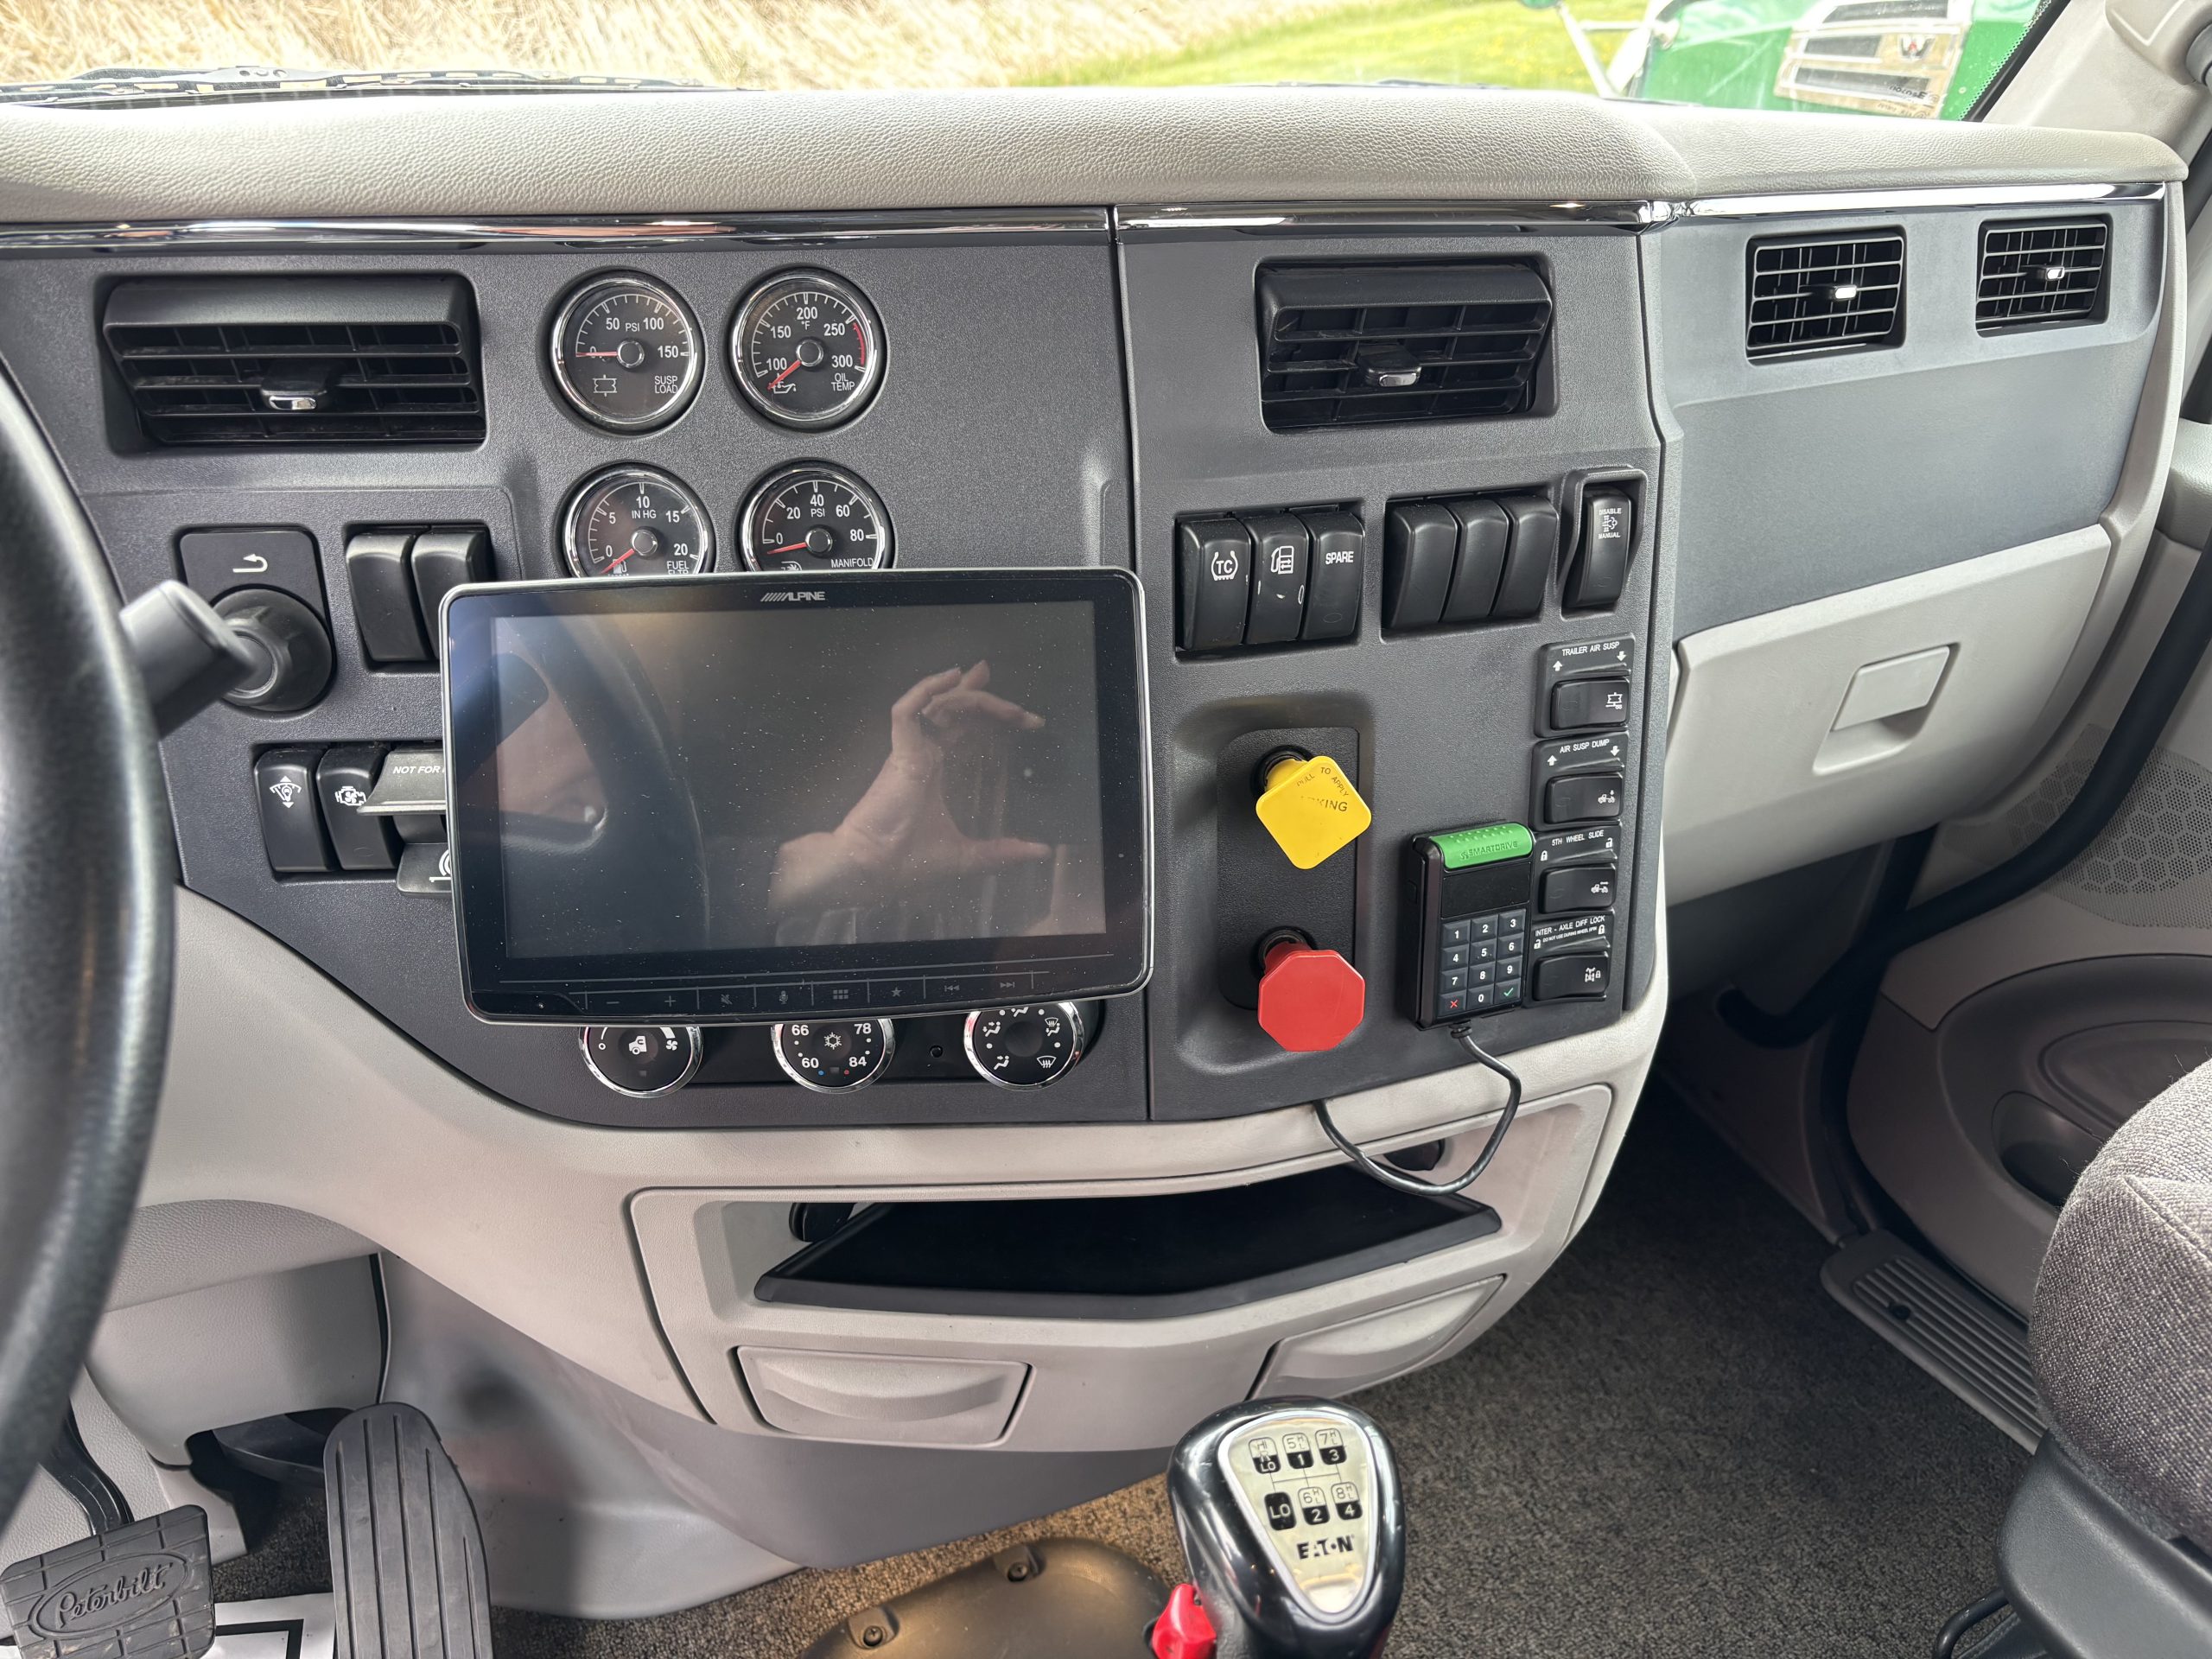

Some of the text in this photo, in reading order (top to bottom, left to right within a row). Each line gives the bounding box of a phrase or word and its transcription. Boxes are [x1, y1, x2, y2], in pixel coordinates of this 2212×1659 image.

[796, 306, 817, 320] 200
[606, 317, 620, 330] 50
[625, 322, 639, 332] PSI
[643, 317, 664, 330] 100
[823, 322, 845, 336] 250
[770, 325, 791, 339] 150
[658, 345, 678, 359] 150
[766, 358, 787, 371] 100
[831, 354, 853, 368] 300
[654, 375, 678, 385] SUSP
[834, 372, 849, 382] OIL
[654, 385, 678, 394] LOAD
[831, 382, 855, 391] TEMP
[636, 496, 650, 508] 10
[810, 493, 824, 506] 40
[609, 512, 616, 524] 5
[632, 510, 657, 519] IN HG
[665, 510, 680, 523] 15
[786, 507, 801, 519] 20
[810, 508, 825, 518] PSI
[836, 505, 850, 518] 60
[1599, 507, 1622, 516] DISABLE
[776, 532, 784, 545] 0
[849, 529, 864, 542] 80
[1598, 531, 1621, 540] MANUAL
[606, 544, 613, 557] 0
[673, 543, 689, 556] 20
[830, 557, 874, 569] MANIFOLD
[1325, 550, 1354, 565] SPARE
[666, 561, 690, 569] FUEL
[1216, 560, 1233, 575] TC
[779, 591, 826, 601] ALPINE
[1561, 641, 1620, 657] TRAILER AIR SUSP
[1560, 739, 1610, 753] AIR SUSP DUMP
[392, 766, 416, 774] NOT
[417, 766, 441, 774] FOR
[1320, 766, 1332, 775] TO
[1331, 776, 1350, 797] APPLY
[1551, 830, 1605, 847] 5TH WHEEL SLIDE
[1468, 841, 1518, 857] SMARTDRIVE
[1454, 918, 1516, 939] 1 2 3
[1535, 926, 1553, 937] INTER
[1559, 922, 1573, 931] AXLE
[1575, 918, 1588, 928] DIFF
[1590, 915, 1605, 925] LOCK
[1452, 942, 1515, 963] 4 5 6
[1452, 964, 1513, 986] 7 8 9
[1478, 994, 1484, 1003] 0
[791, 1024, 810, 1036] 66
[854, 1022, 872, 1034] 78
[801, 1058, 819, 1068] 60
[849, 1056, 868, 1067] 84
[1287, 1437, 1297, 1451] 5
[1319, 1433, 1328, 1446] 7
[1297, 1453, 1305, 1465] 1
[1329, 1449, 1340, 1461] 3
[1261, 1461, 1276, 1471] LO
[1303, 1491, 1313, 1503] 6
[1336, 1487, 1346, 1499] 8
[1269, 1503, 1291, 1519] LO
[1311, 1509, 1322, 1522] 2
[1344, 1504, 1356, 1516] 4
[55, 1562, 173, 1629] Peterbilt
